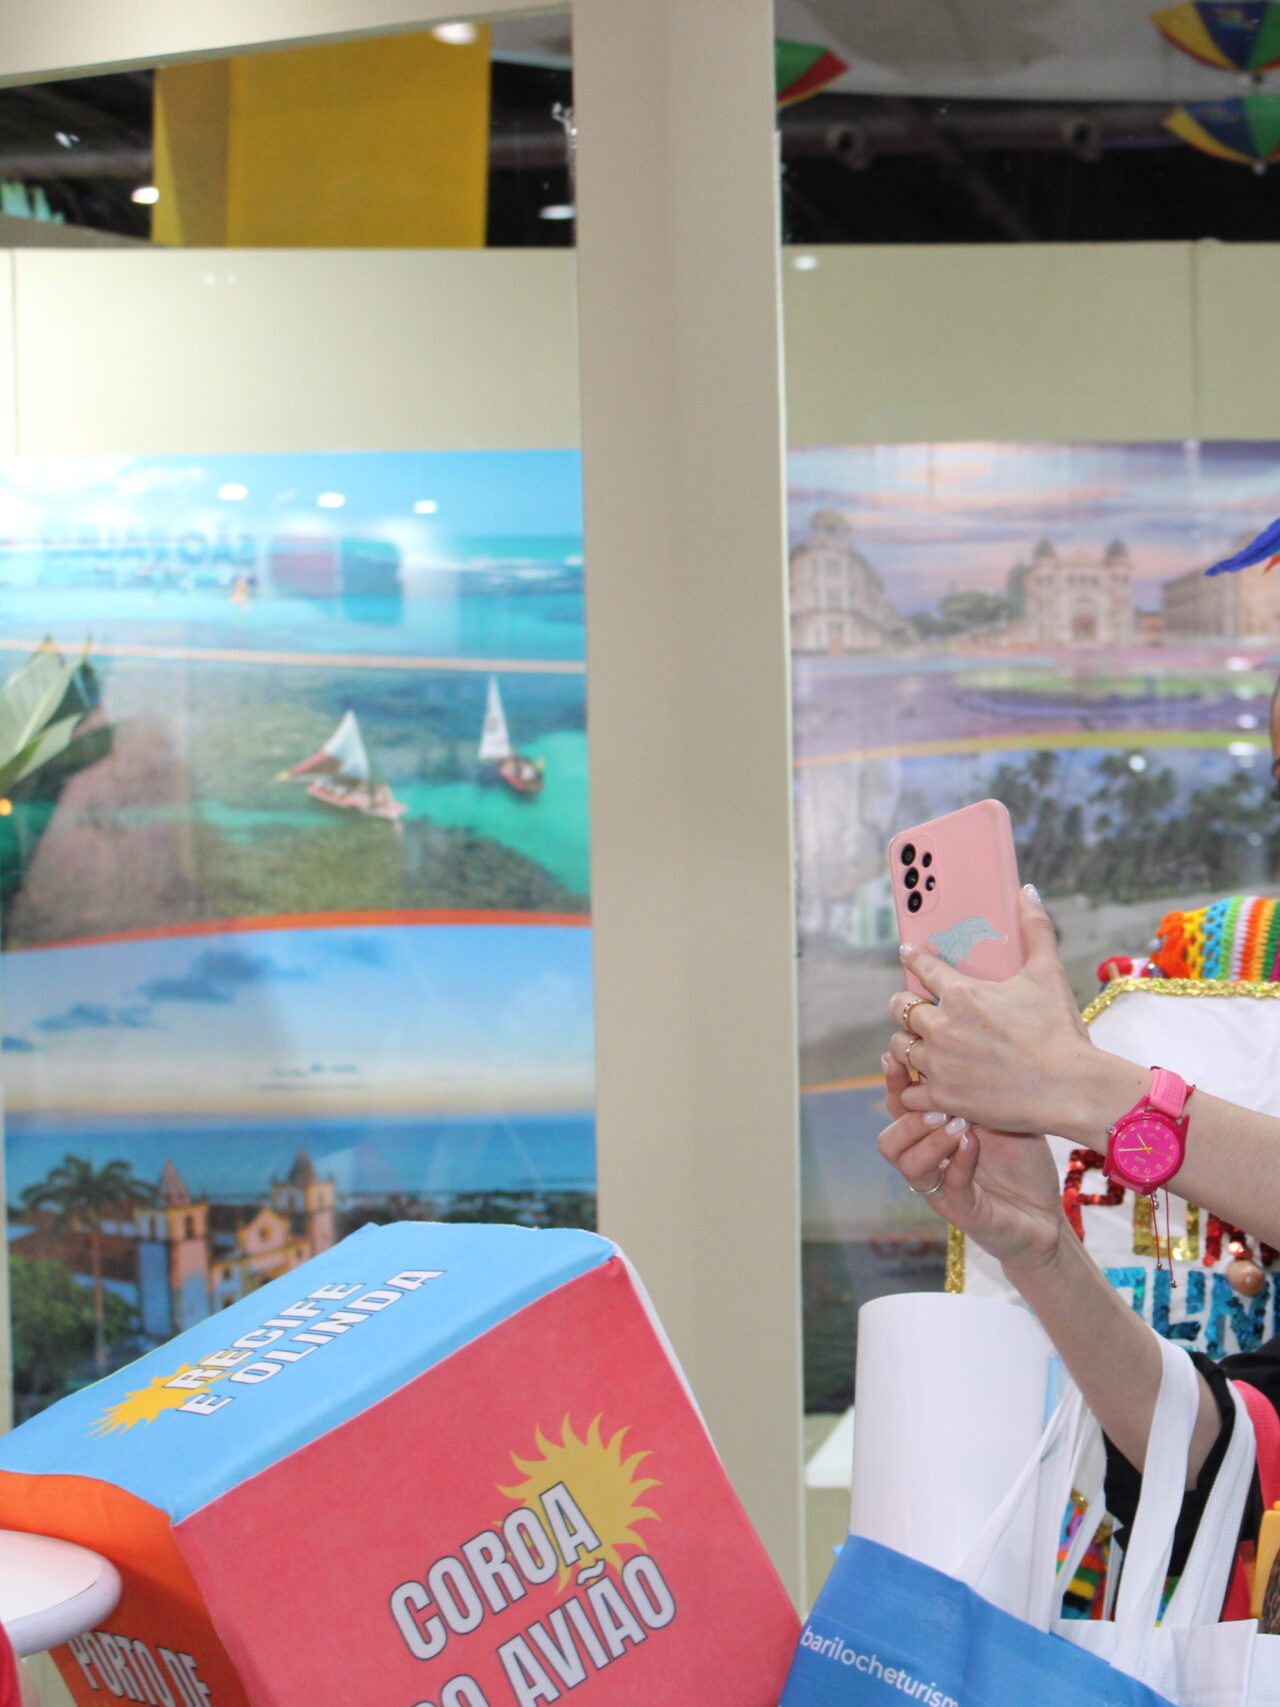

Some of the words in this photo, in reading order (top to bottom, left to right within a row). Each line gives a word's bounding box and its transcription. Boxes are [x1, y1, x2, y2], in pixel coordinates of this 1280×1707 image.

[162, 1282, 367, 1390] RECIFE
[176, 1393, 236, 1416] E
[229, 1269, 447, 1385] OLINDA
[389, 1480, 603, 1661] COROA
[496, 1558, 677, 1707] AVIÃO
[66, 1630, 178, 1707] PORTO
[155, 1645, 214, 1707] DE
